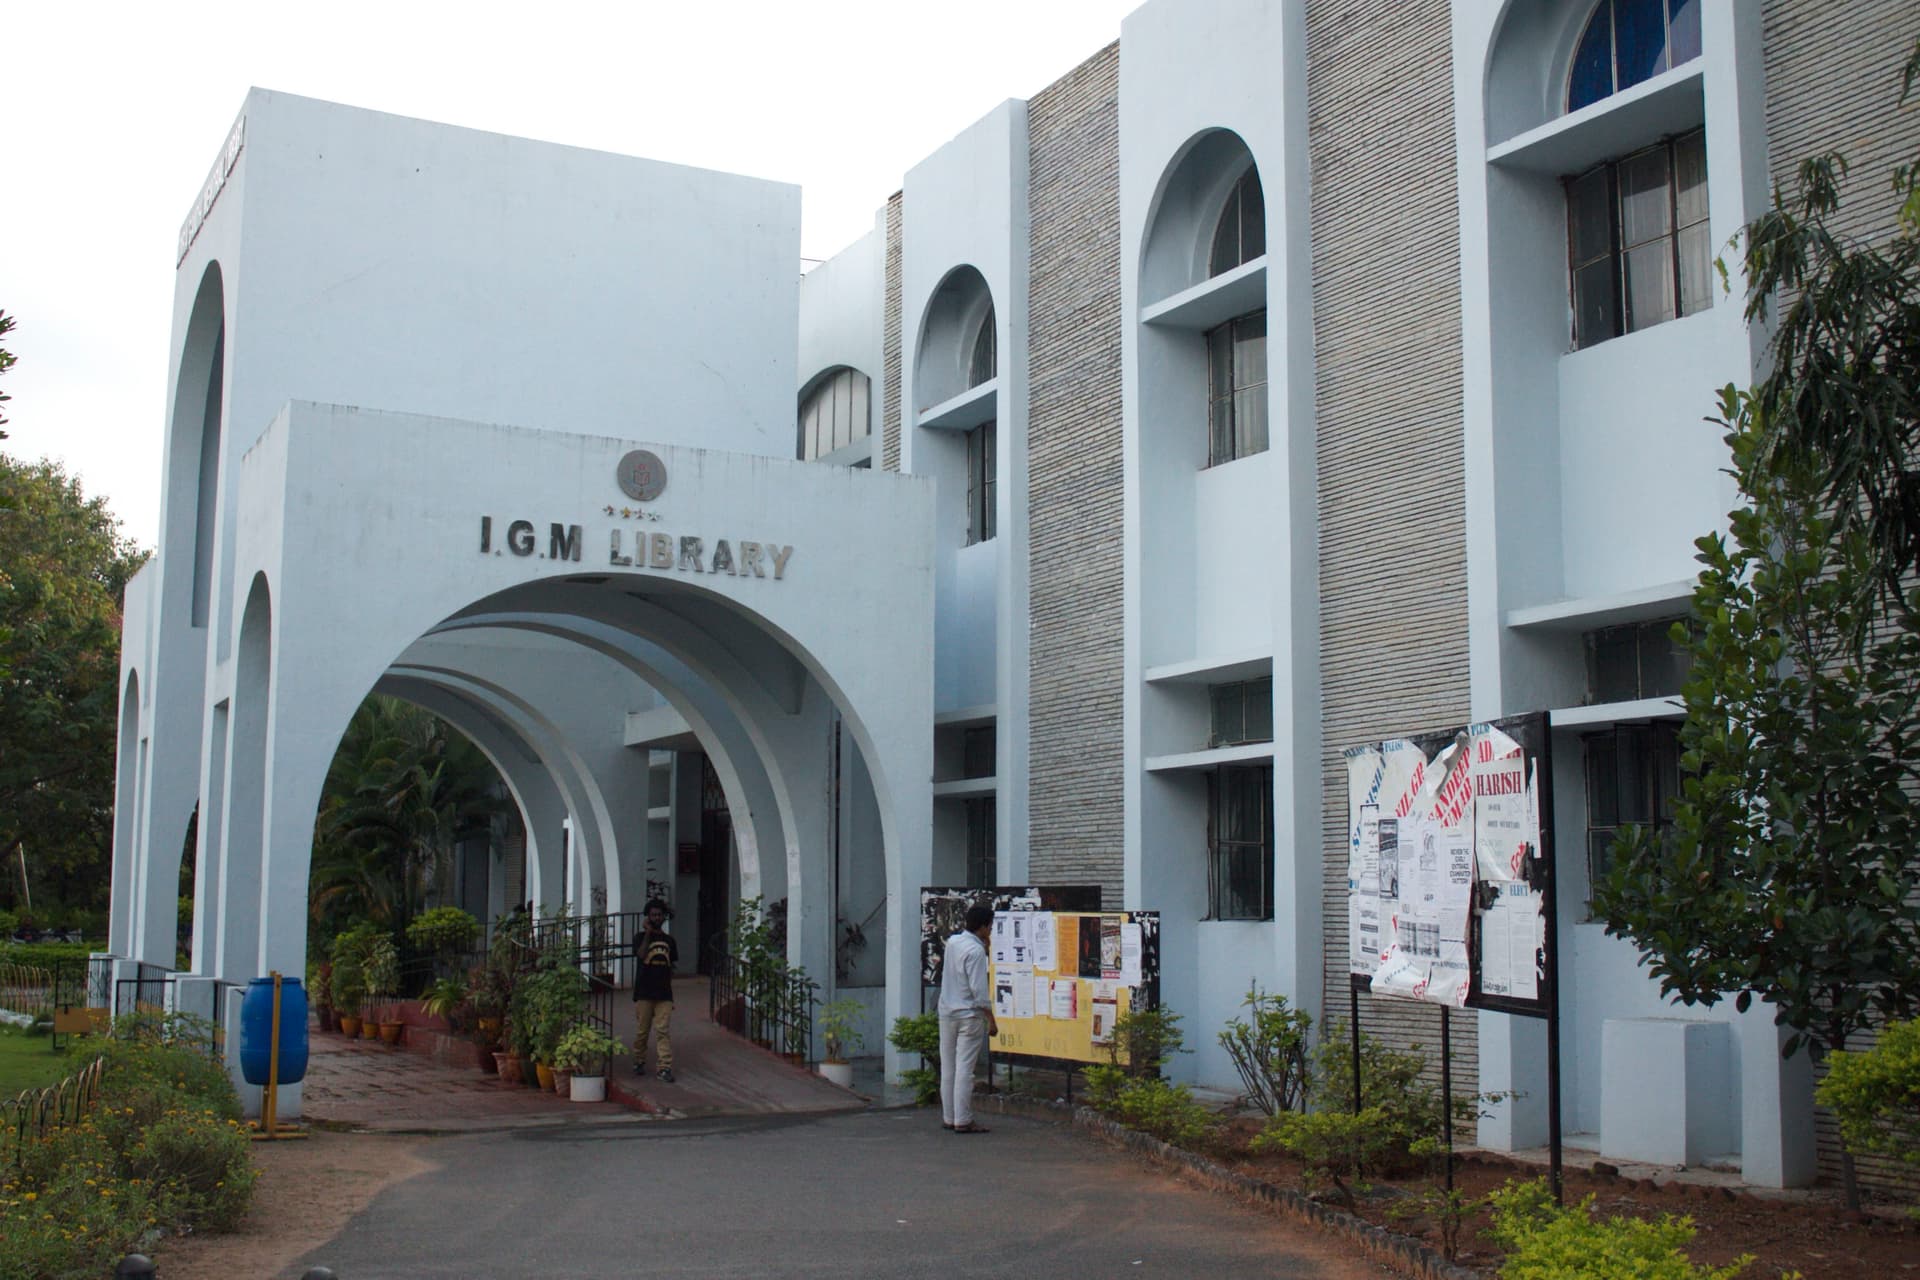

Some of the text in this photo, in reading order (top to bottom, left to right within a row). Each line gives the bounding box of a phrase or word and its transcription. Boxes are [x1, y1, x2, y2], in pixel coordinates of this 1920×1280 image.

[480, 516, 794, 580] I.G.M LIBRARY
[1476, 771, 1522, 797] HARISH
